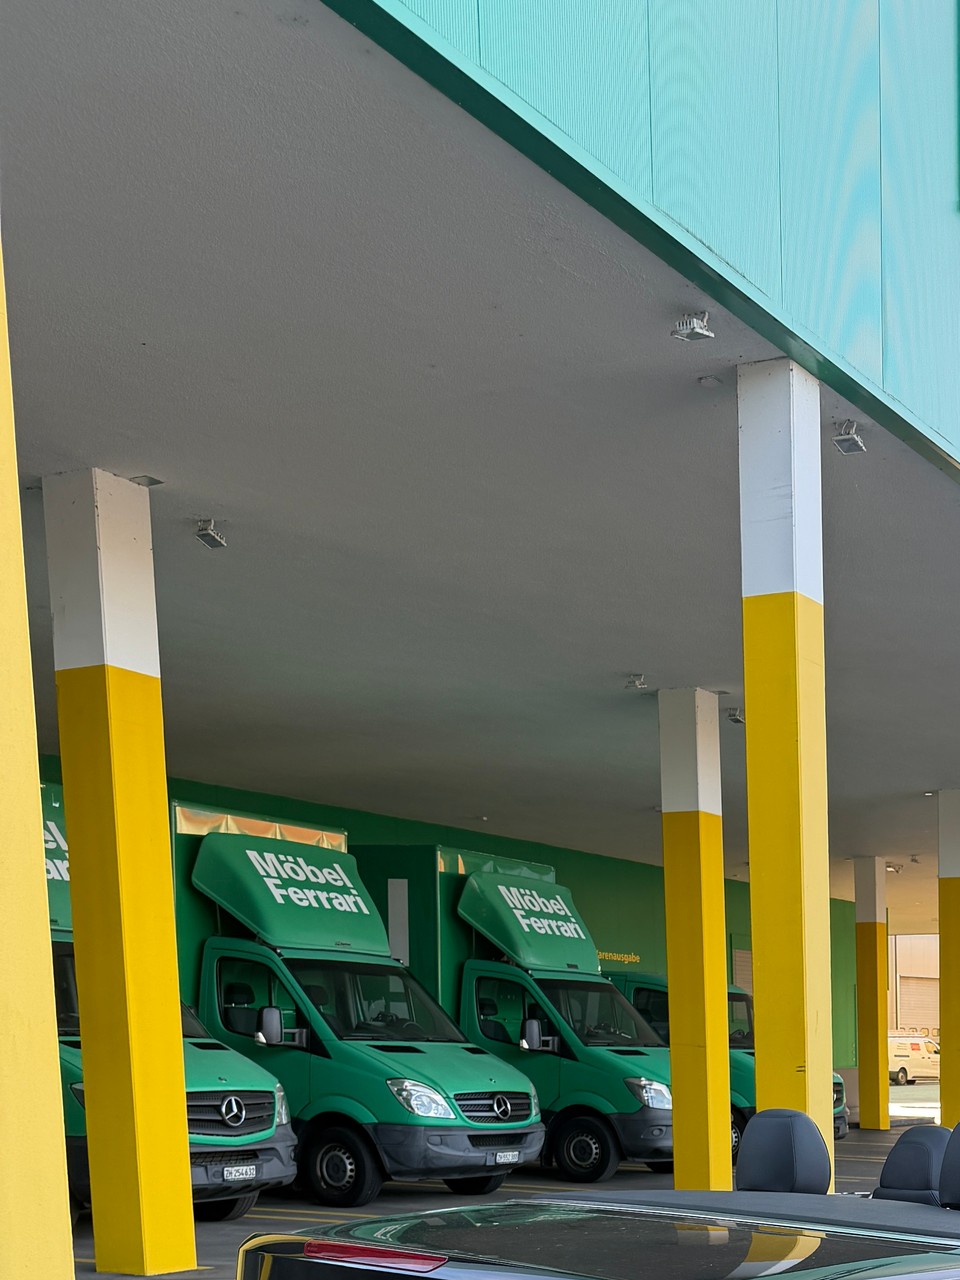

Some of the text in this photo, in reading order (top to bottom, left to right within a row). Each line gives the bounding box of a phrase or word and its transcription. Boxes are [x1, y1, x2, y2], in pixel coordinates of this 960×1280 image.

[245, 849, 354, 888] Möbel
[263, 877, 370, 915] Ferrari
[497, 885, 572, 917] Möbel
[512, 909, 586, 940] Ferrari
[596, 950, 641, 964] arenausgabe
